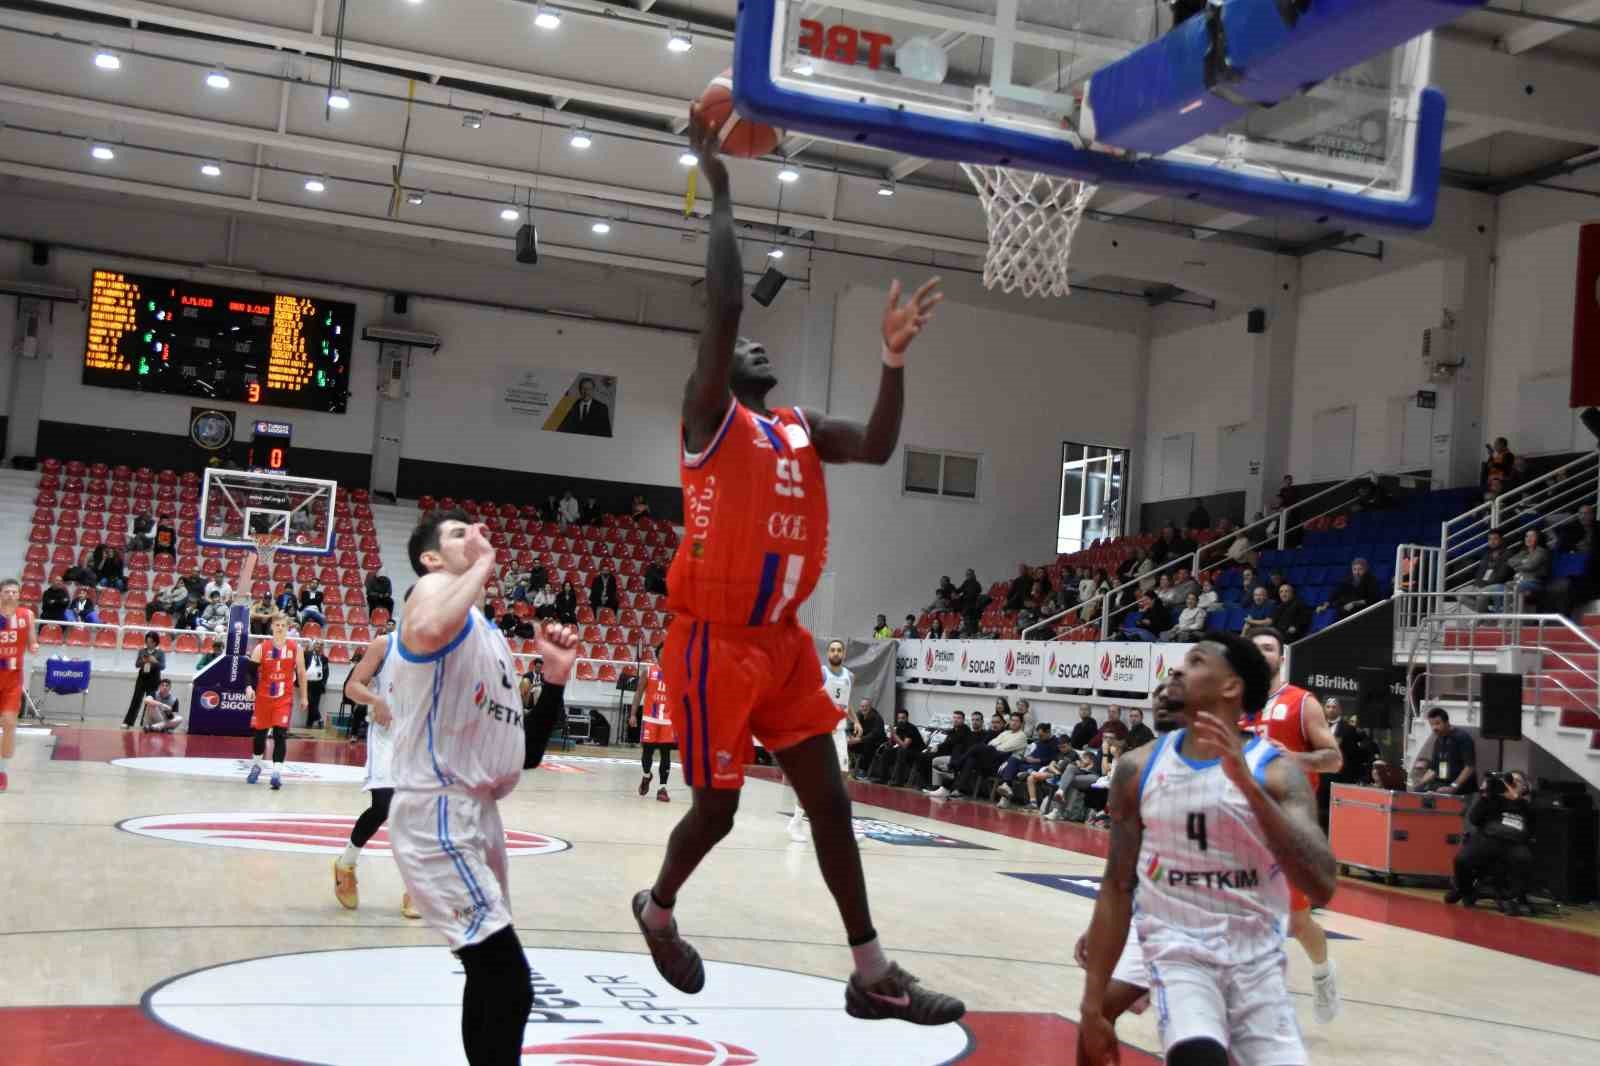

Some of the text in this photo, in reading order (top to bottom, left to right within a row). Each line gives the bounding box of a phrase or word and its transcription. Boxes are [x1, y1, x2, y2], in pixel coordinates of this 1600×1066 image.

[249, 383, 260, 402] 3
[271, 448, 282, 468] 0
[969, 660, 996, 674] SOCAR
[1017, 652, 1040, 665] Petkim
[1115, 655, 1144, 669] Petkim
[1058, 663, 1090, 679] SOCAR
[1187, 812, 1207, 850] 4
[584, 974, 700, 1025] SPOR
